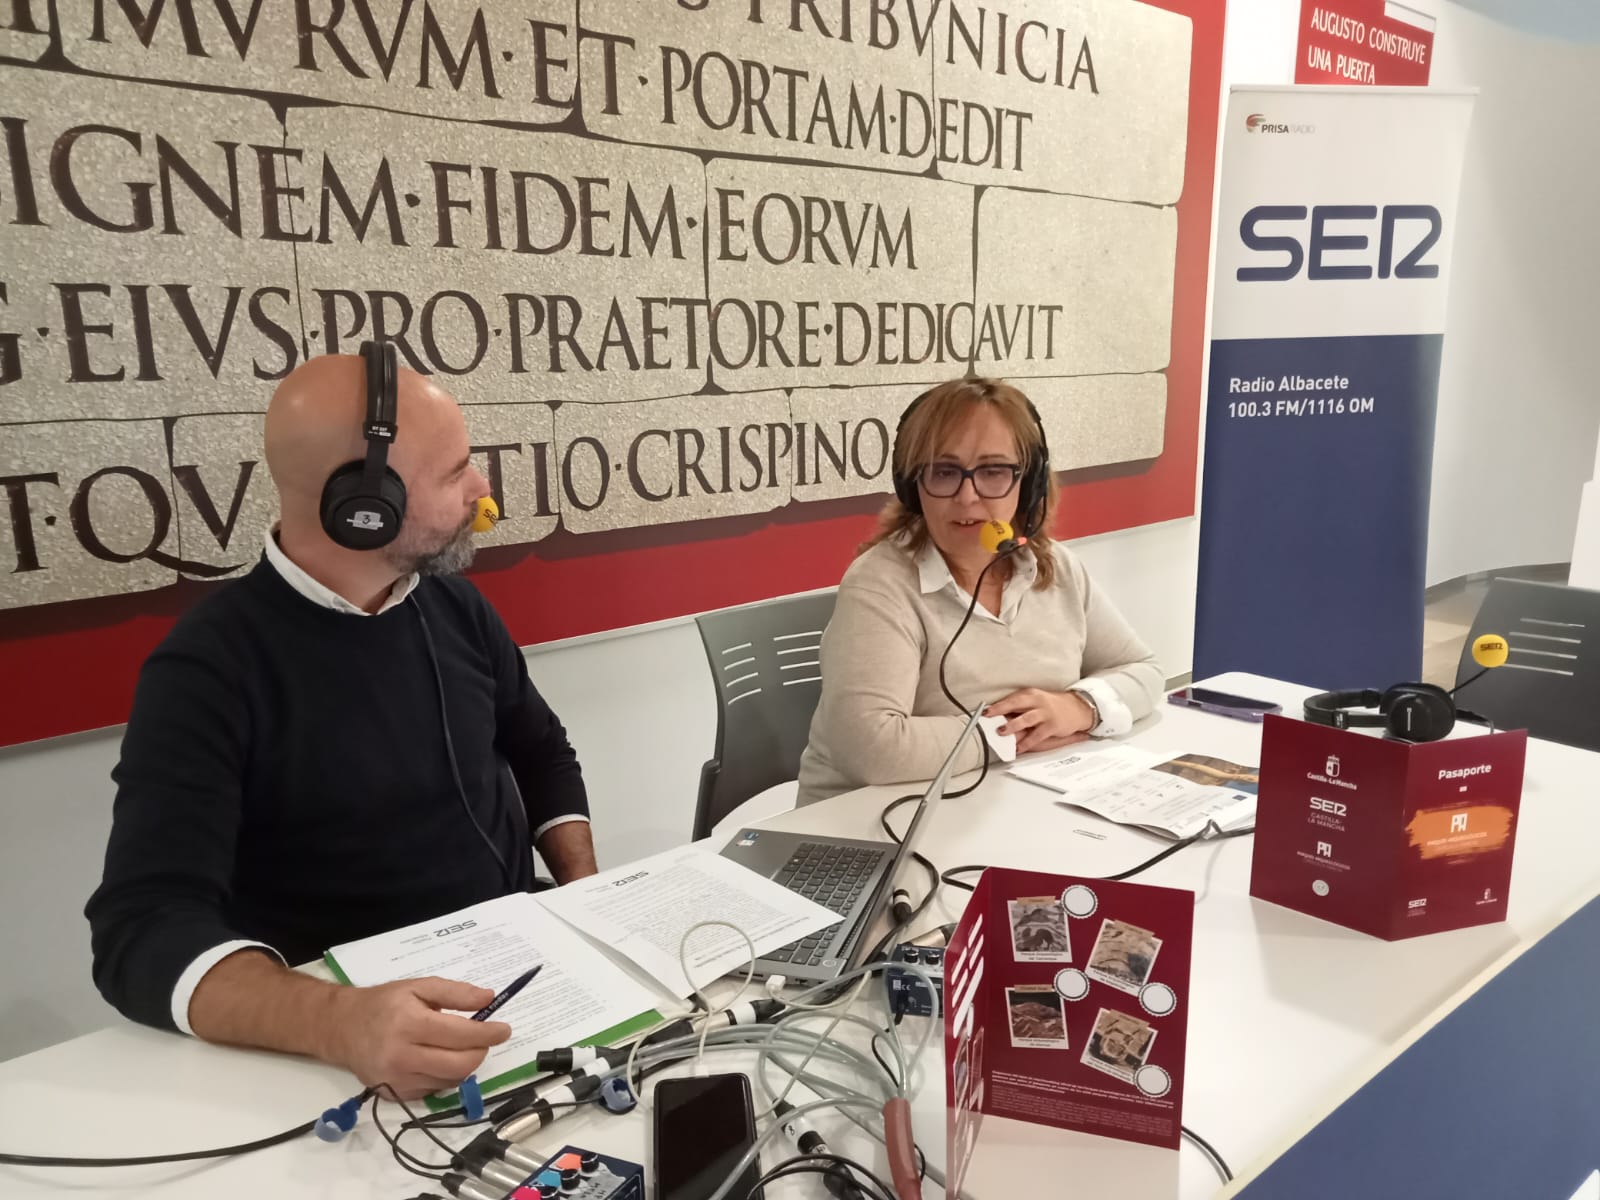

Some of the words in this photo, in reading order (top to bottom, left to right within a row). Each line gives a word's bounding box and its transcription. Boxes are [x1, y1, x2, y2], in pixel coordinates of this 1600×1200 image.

[1310, 7, 1366, 44] AUGUSTO
[1369, 27, 1427, 64] CONSTRUYE
[1307, 44, 1332, 73] UNA
[1336, 54, 1376, 85] PUERTA
[658, 45, 892, 154] PORTAM
[897, 88, 1033, 171] DEDIT
[1261, 123, 1290, 134] PRISA
[425, 161, 687, 260] FIDEM
[714, 187, 918, 270] EORVM
[1236, 204, 1443, 282] SER
[501, 292, 822, 373] PRAETORE
[832, 301, 1064, 367] DEDICAVIT
[1228, 401, 1272, 418] 100.3
[1275, 398, 1345, 416] FM/1116
[1349, 397, 1375, 414] OM
[1229, 376, 1275, 393] Radio
[1278, 375, 1349, 392] Albacete
[627, 417, 890, 502] CRISPINO
[1438, 764, 1493, 780] Pasaporte
[1309, 796, 1348, 817] SER
